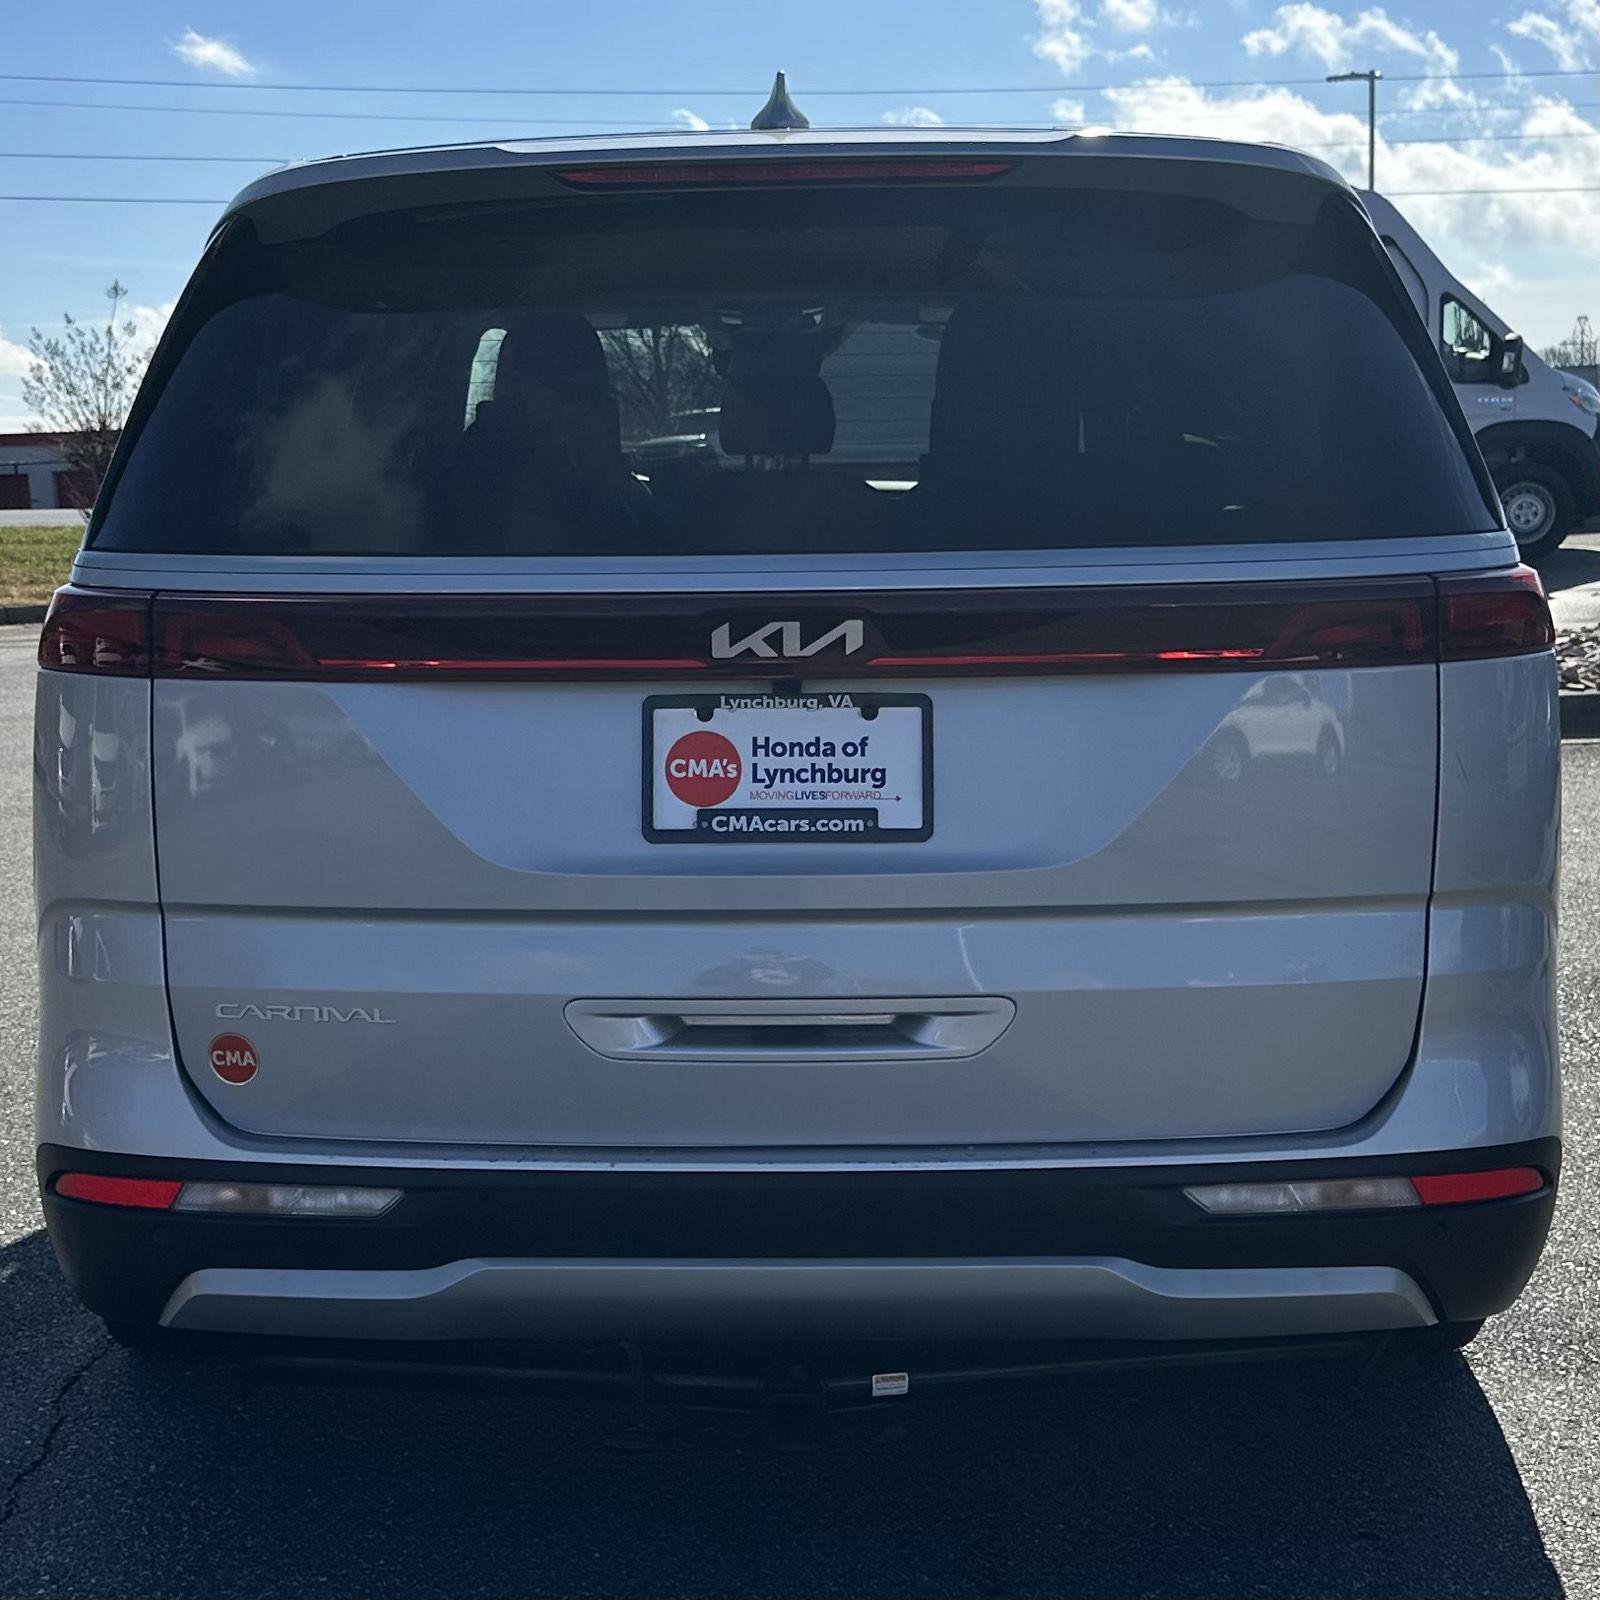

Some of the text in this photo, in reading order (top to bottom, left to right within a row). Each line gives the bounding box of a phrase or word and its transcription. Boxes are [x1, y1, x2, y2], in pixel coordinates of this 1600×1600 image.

[711, 619, 864, 659] KIA
[720, 694, 854, 712] Lynchburg, VA
[751, 736, 869, 757] Honda of
[669, 758, 738, 778] CMA's
[751, 763, 887, 789] Lynchburg
[711, 815, 865, 832] CMAcars.com
[214, 1003, 397, 1024] CARNIVAL
[212, 1050, 256, 1067] CMA
